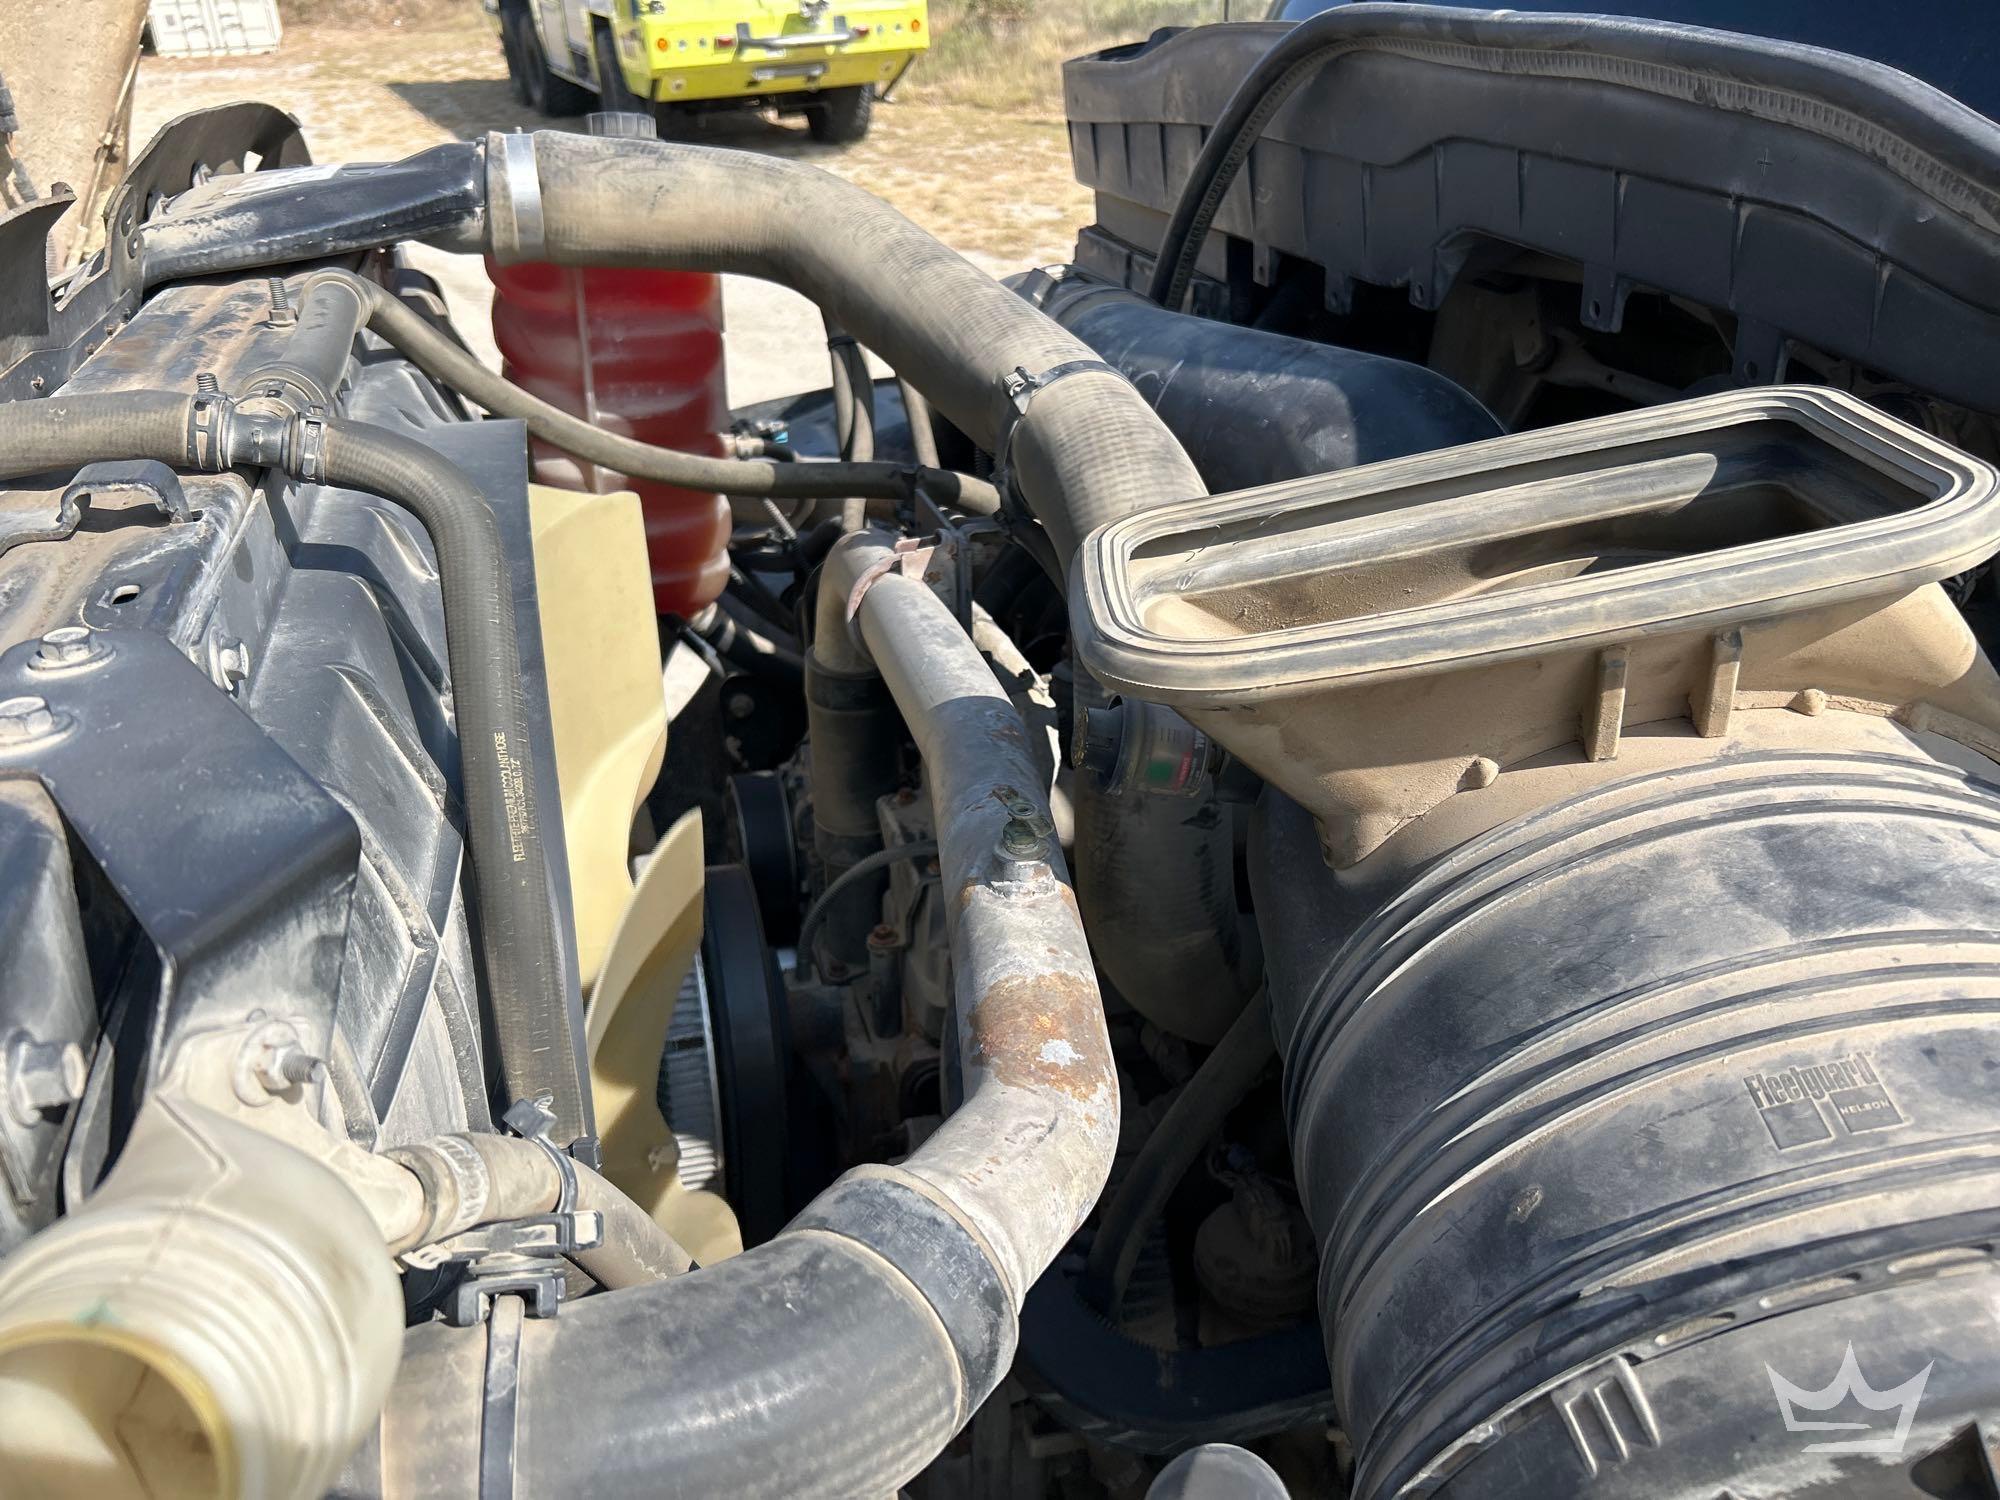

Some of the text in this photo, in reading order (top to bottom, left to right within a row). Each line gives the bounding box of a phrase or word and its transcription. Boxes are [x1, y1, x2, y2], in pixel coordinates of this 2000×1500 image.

[494, 731, 507, 753] HOSE
[497, 754, 513, 788] COOLANT
[1743, 1051, 1879, 1109] Fleetguard
